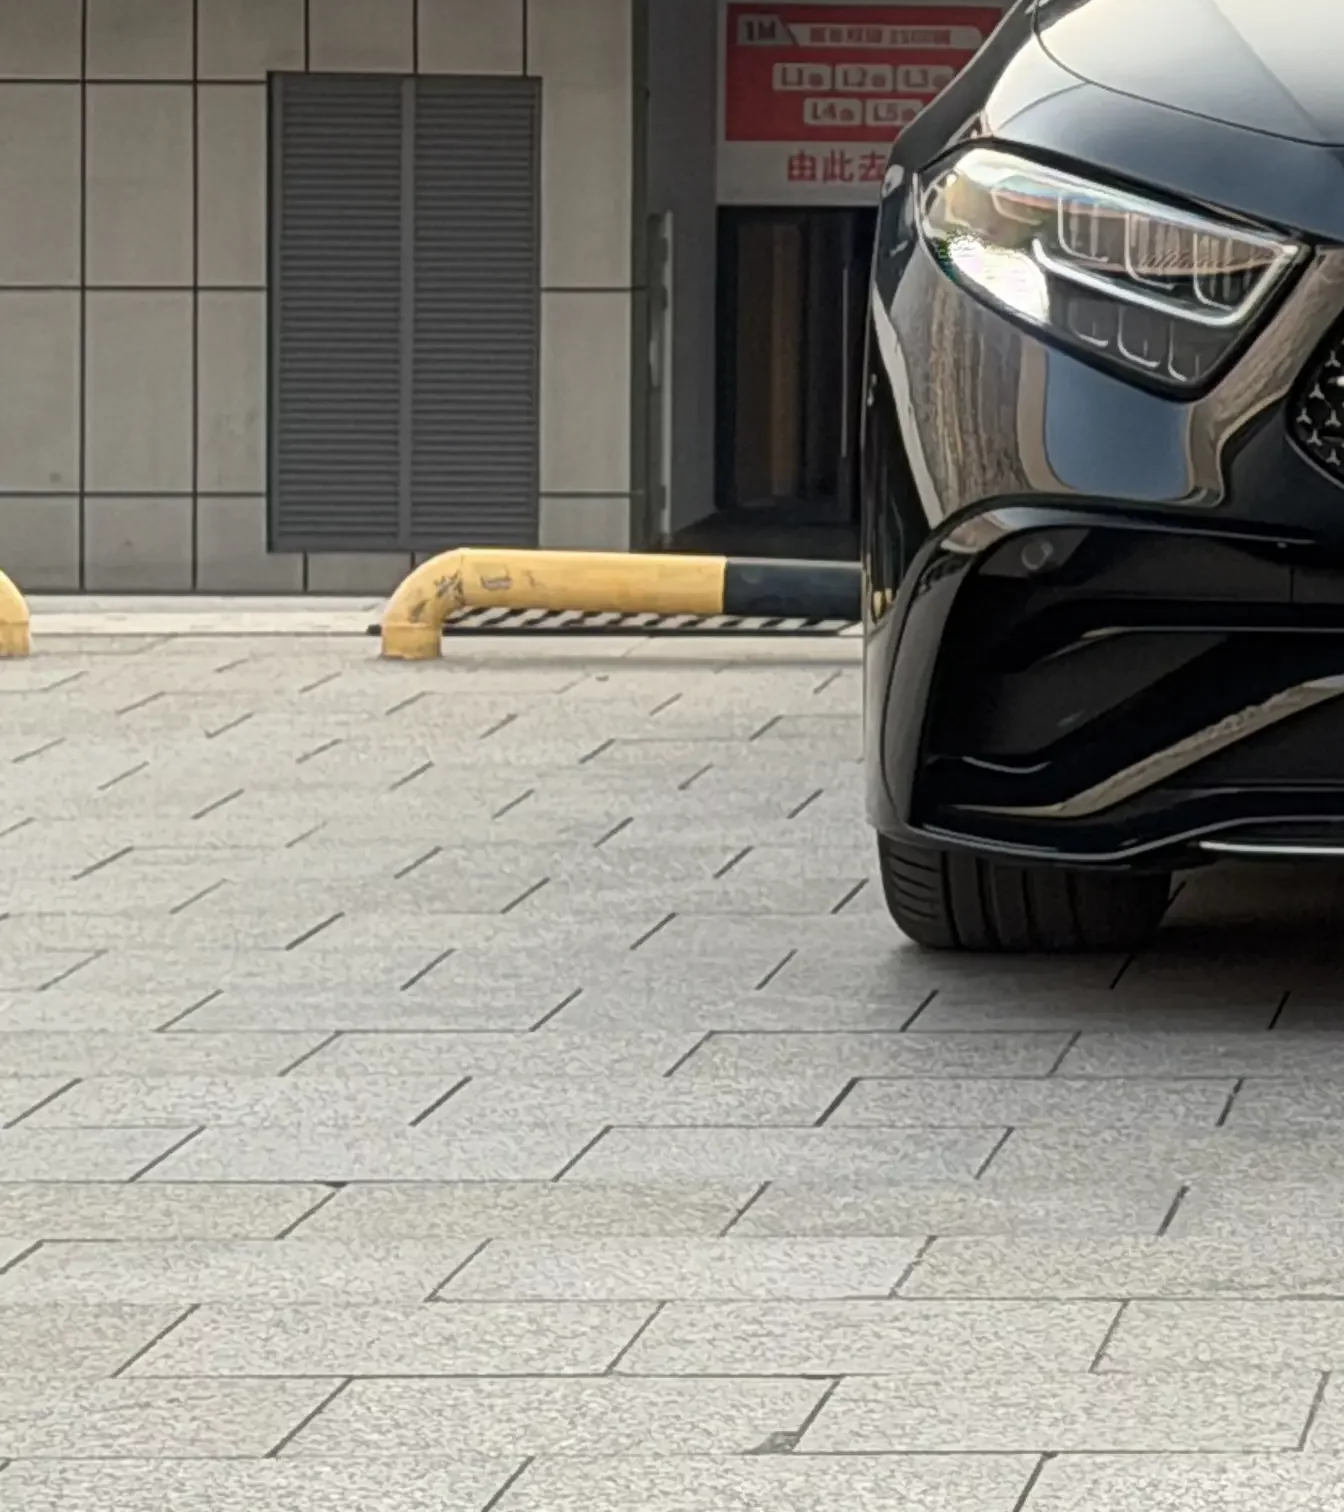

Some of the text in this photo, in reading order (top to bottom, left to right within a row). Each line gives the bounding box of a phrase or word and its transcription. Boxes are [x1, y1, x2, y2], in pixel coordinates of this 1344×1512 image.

[842, 69, 867, 88] L2
[787, 149, 887, 182] 由此去
